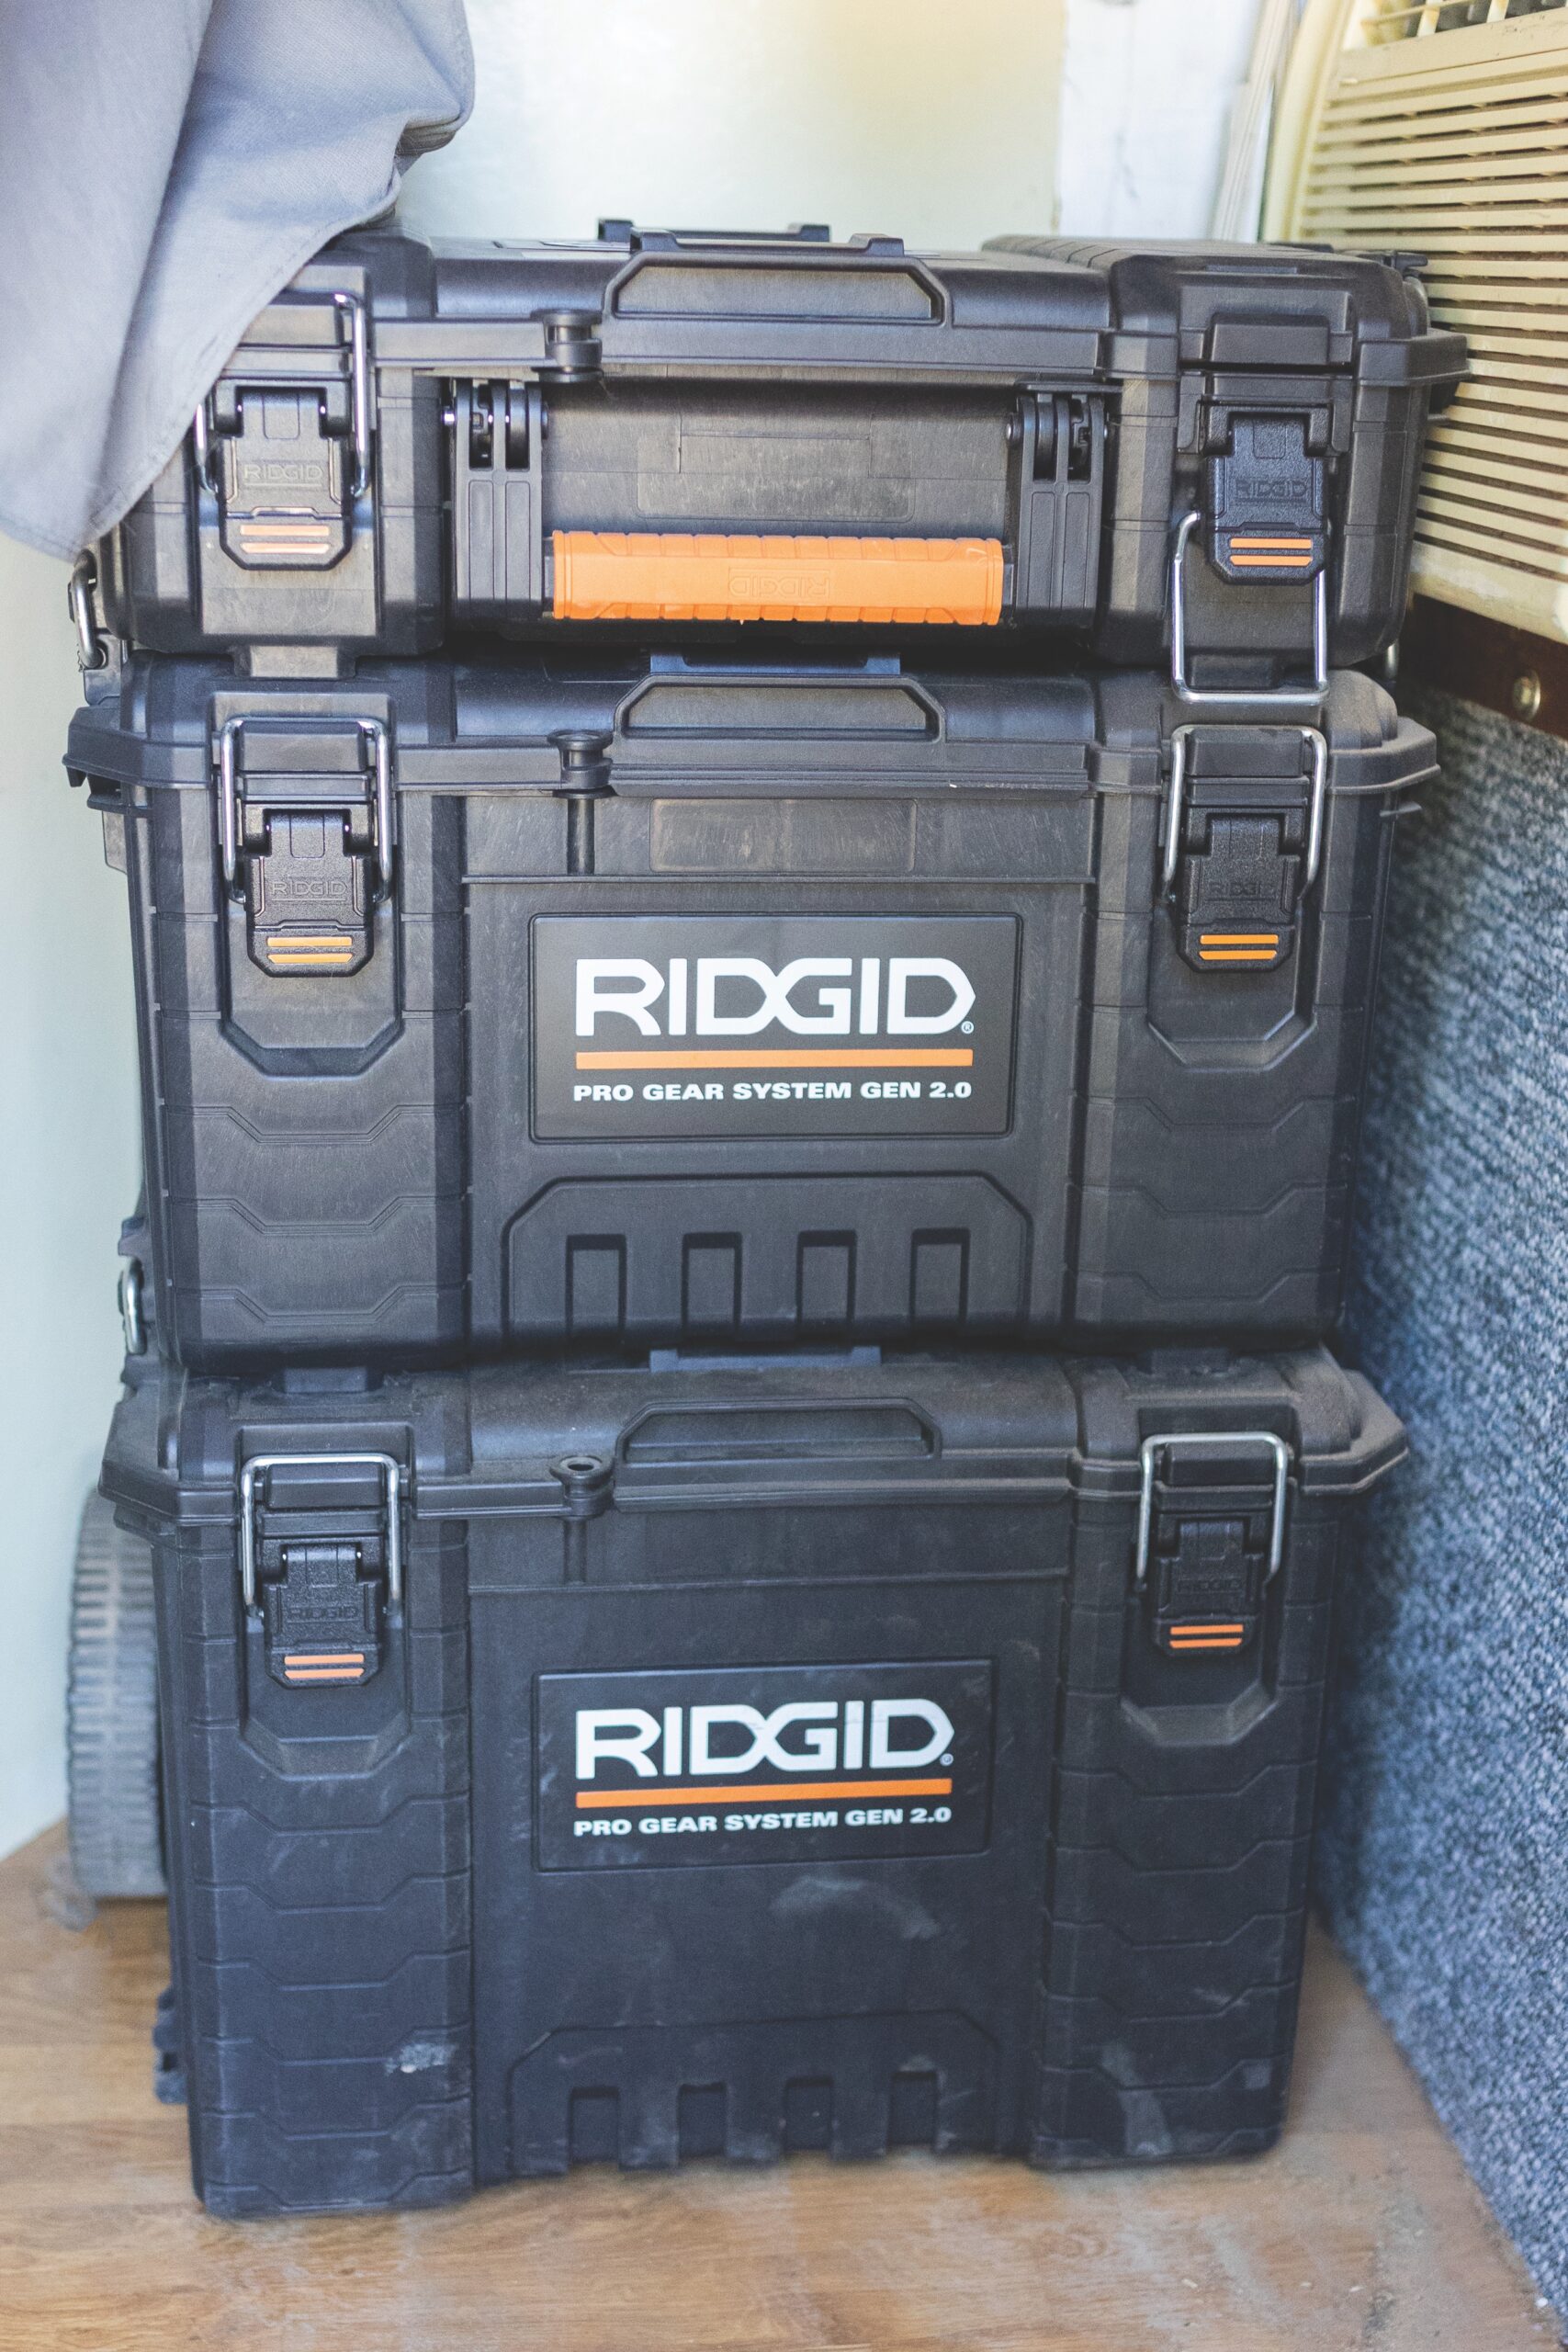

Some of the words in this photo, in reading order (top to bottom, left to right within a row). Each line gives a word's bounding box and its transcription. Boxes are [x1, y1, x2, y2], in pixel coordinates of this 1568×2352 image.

[243, 463, 322, 481] RIDGID
[1235, 479, 1308, 497] RIDGID
[728, 575, 830, 598] RIDGID
[272, 881, 348, 896] RIDGID
[572, 1083, 634, 1102] PRO
[641, 1083, 725, 1102] GEAR
[732, 1081, 852, 1101] SYSTEM
[859, 1081, 921, 1100] GEN
[929, 1081, 973, 1099] 2.0
[573, 1818, 633, 1837] PRO
[637, 1815, 718, 1835] GEAR
[724, 1811, 839, 1831] SYSTEM
[844, 1808, 904, 1826] GEN
[909, 1806, 953, 1824] 2.0
